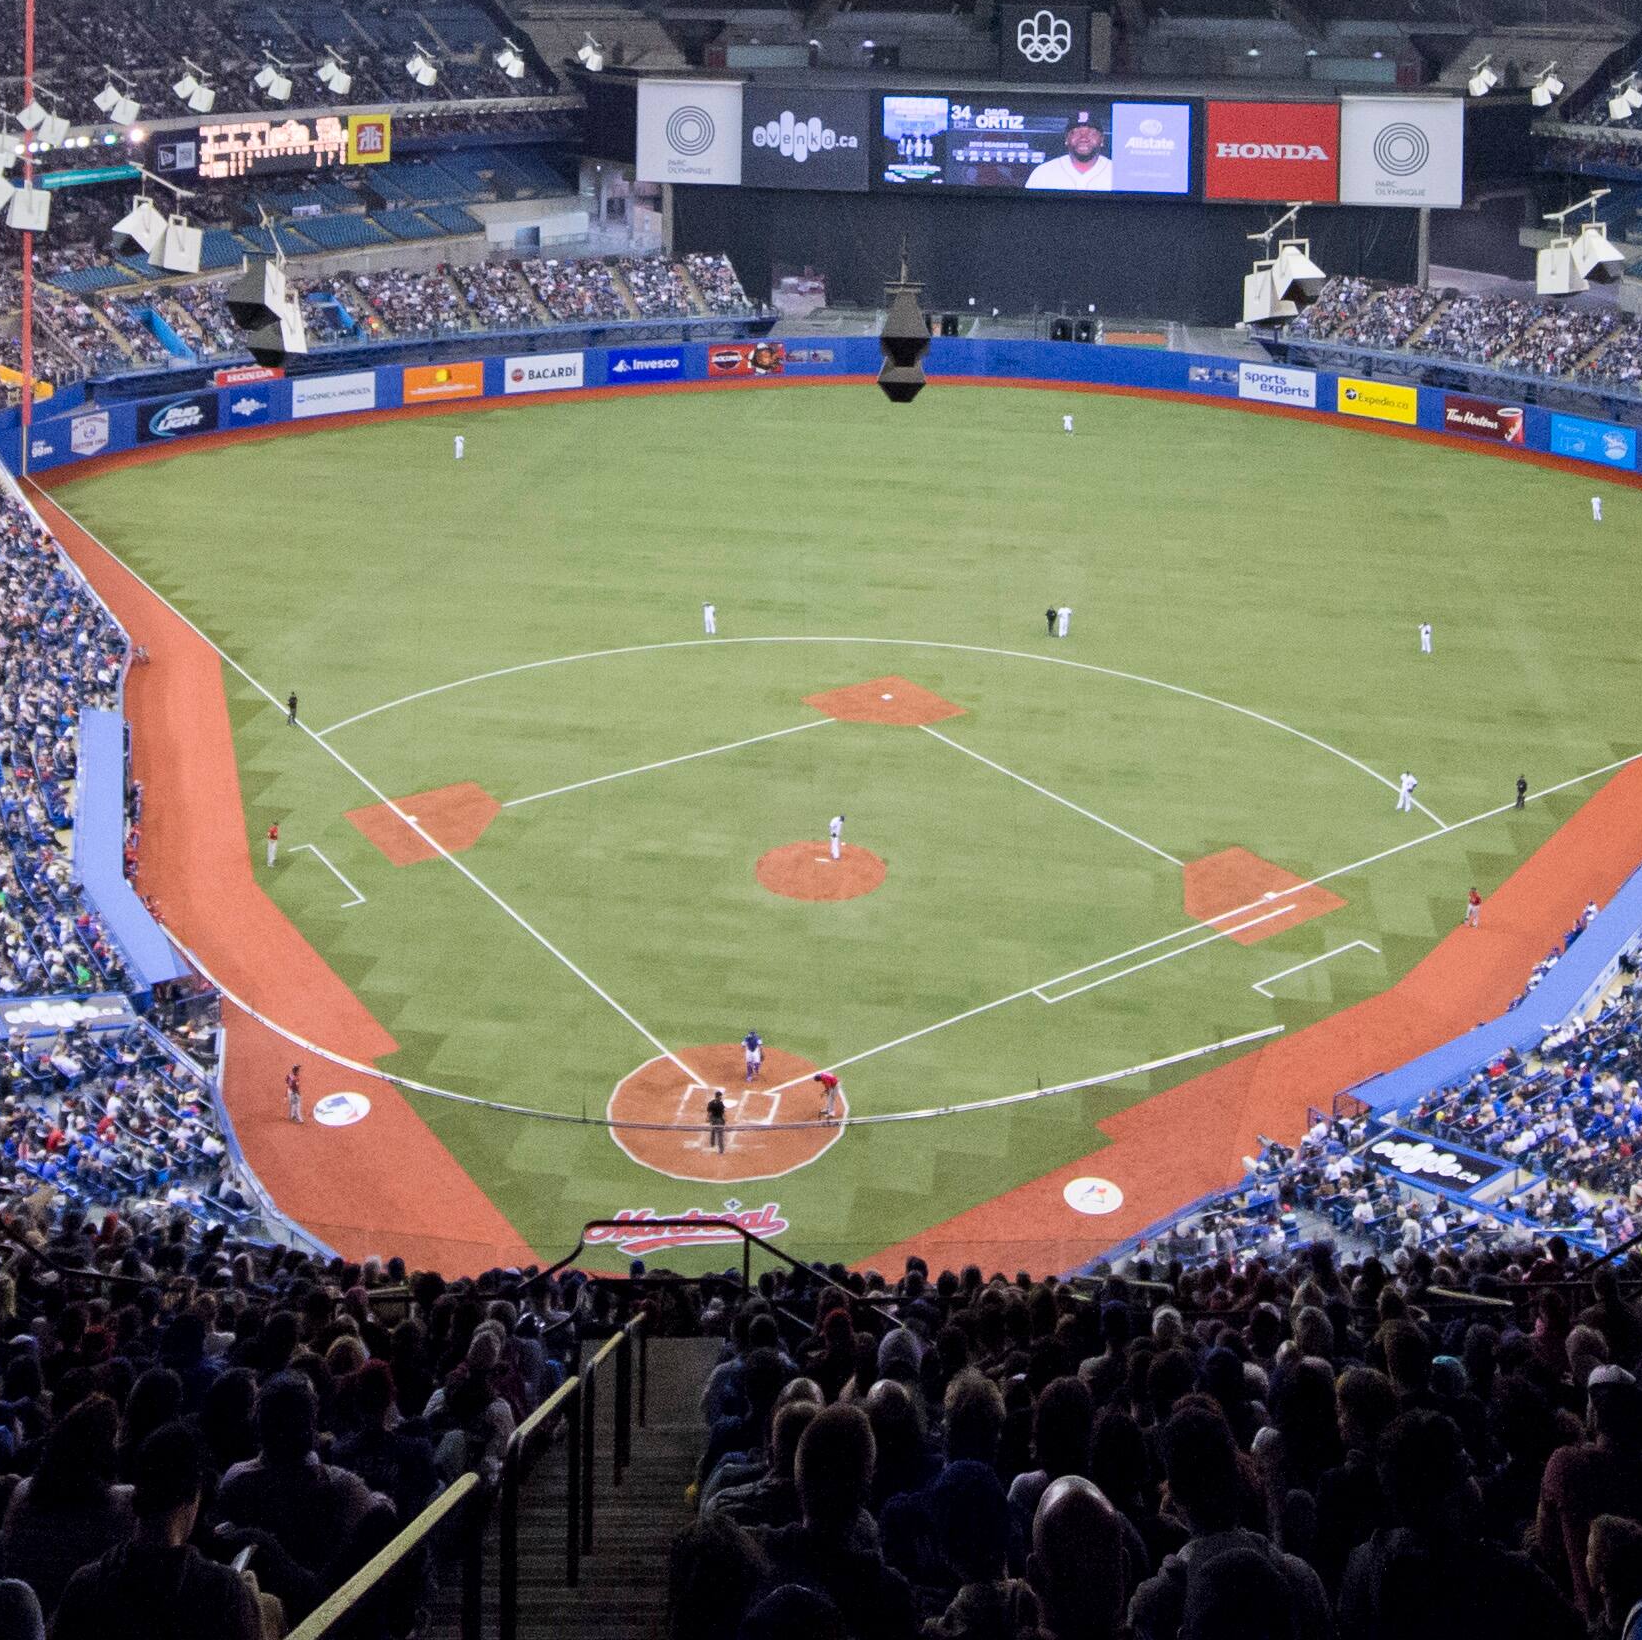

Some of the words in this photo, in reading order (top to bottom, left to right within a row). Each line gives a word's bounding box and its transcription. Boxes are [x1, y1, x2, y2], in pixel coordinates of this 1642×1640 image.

[951, 105, 972, 120] 34
[975, 115, 1025, 129] ORTIZ
[752, 111, 857, 162] evenko.ca
[1125, 136, 1175, 151] Allstate
[1216, 143, 1329, 160] HONDA
[667, 166, 711, 175] OLYMPIQUE
[1375, 187, 1426, 197] OLYMPIQUE
[632, 357, 679, 369] Invesco
[227, 368, 274, 382] HONDA
[528, 362, 577, 380] BACARDÍ
[1244, 372, 1287, 386] sports
[1260, 383, 1310, 398] experts
[1358, 392, 1408, 410] Expedia.ca
[166, 406, 200, 419] BUD
[1446, 409, 1463, 423] Tim
[1464, 413, 1499, 429] Hortons
[157, 414, 204, 431] LIGHT
[583, 1203, 789, 1244] Montreal
